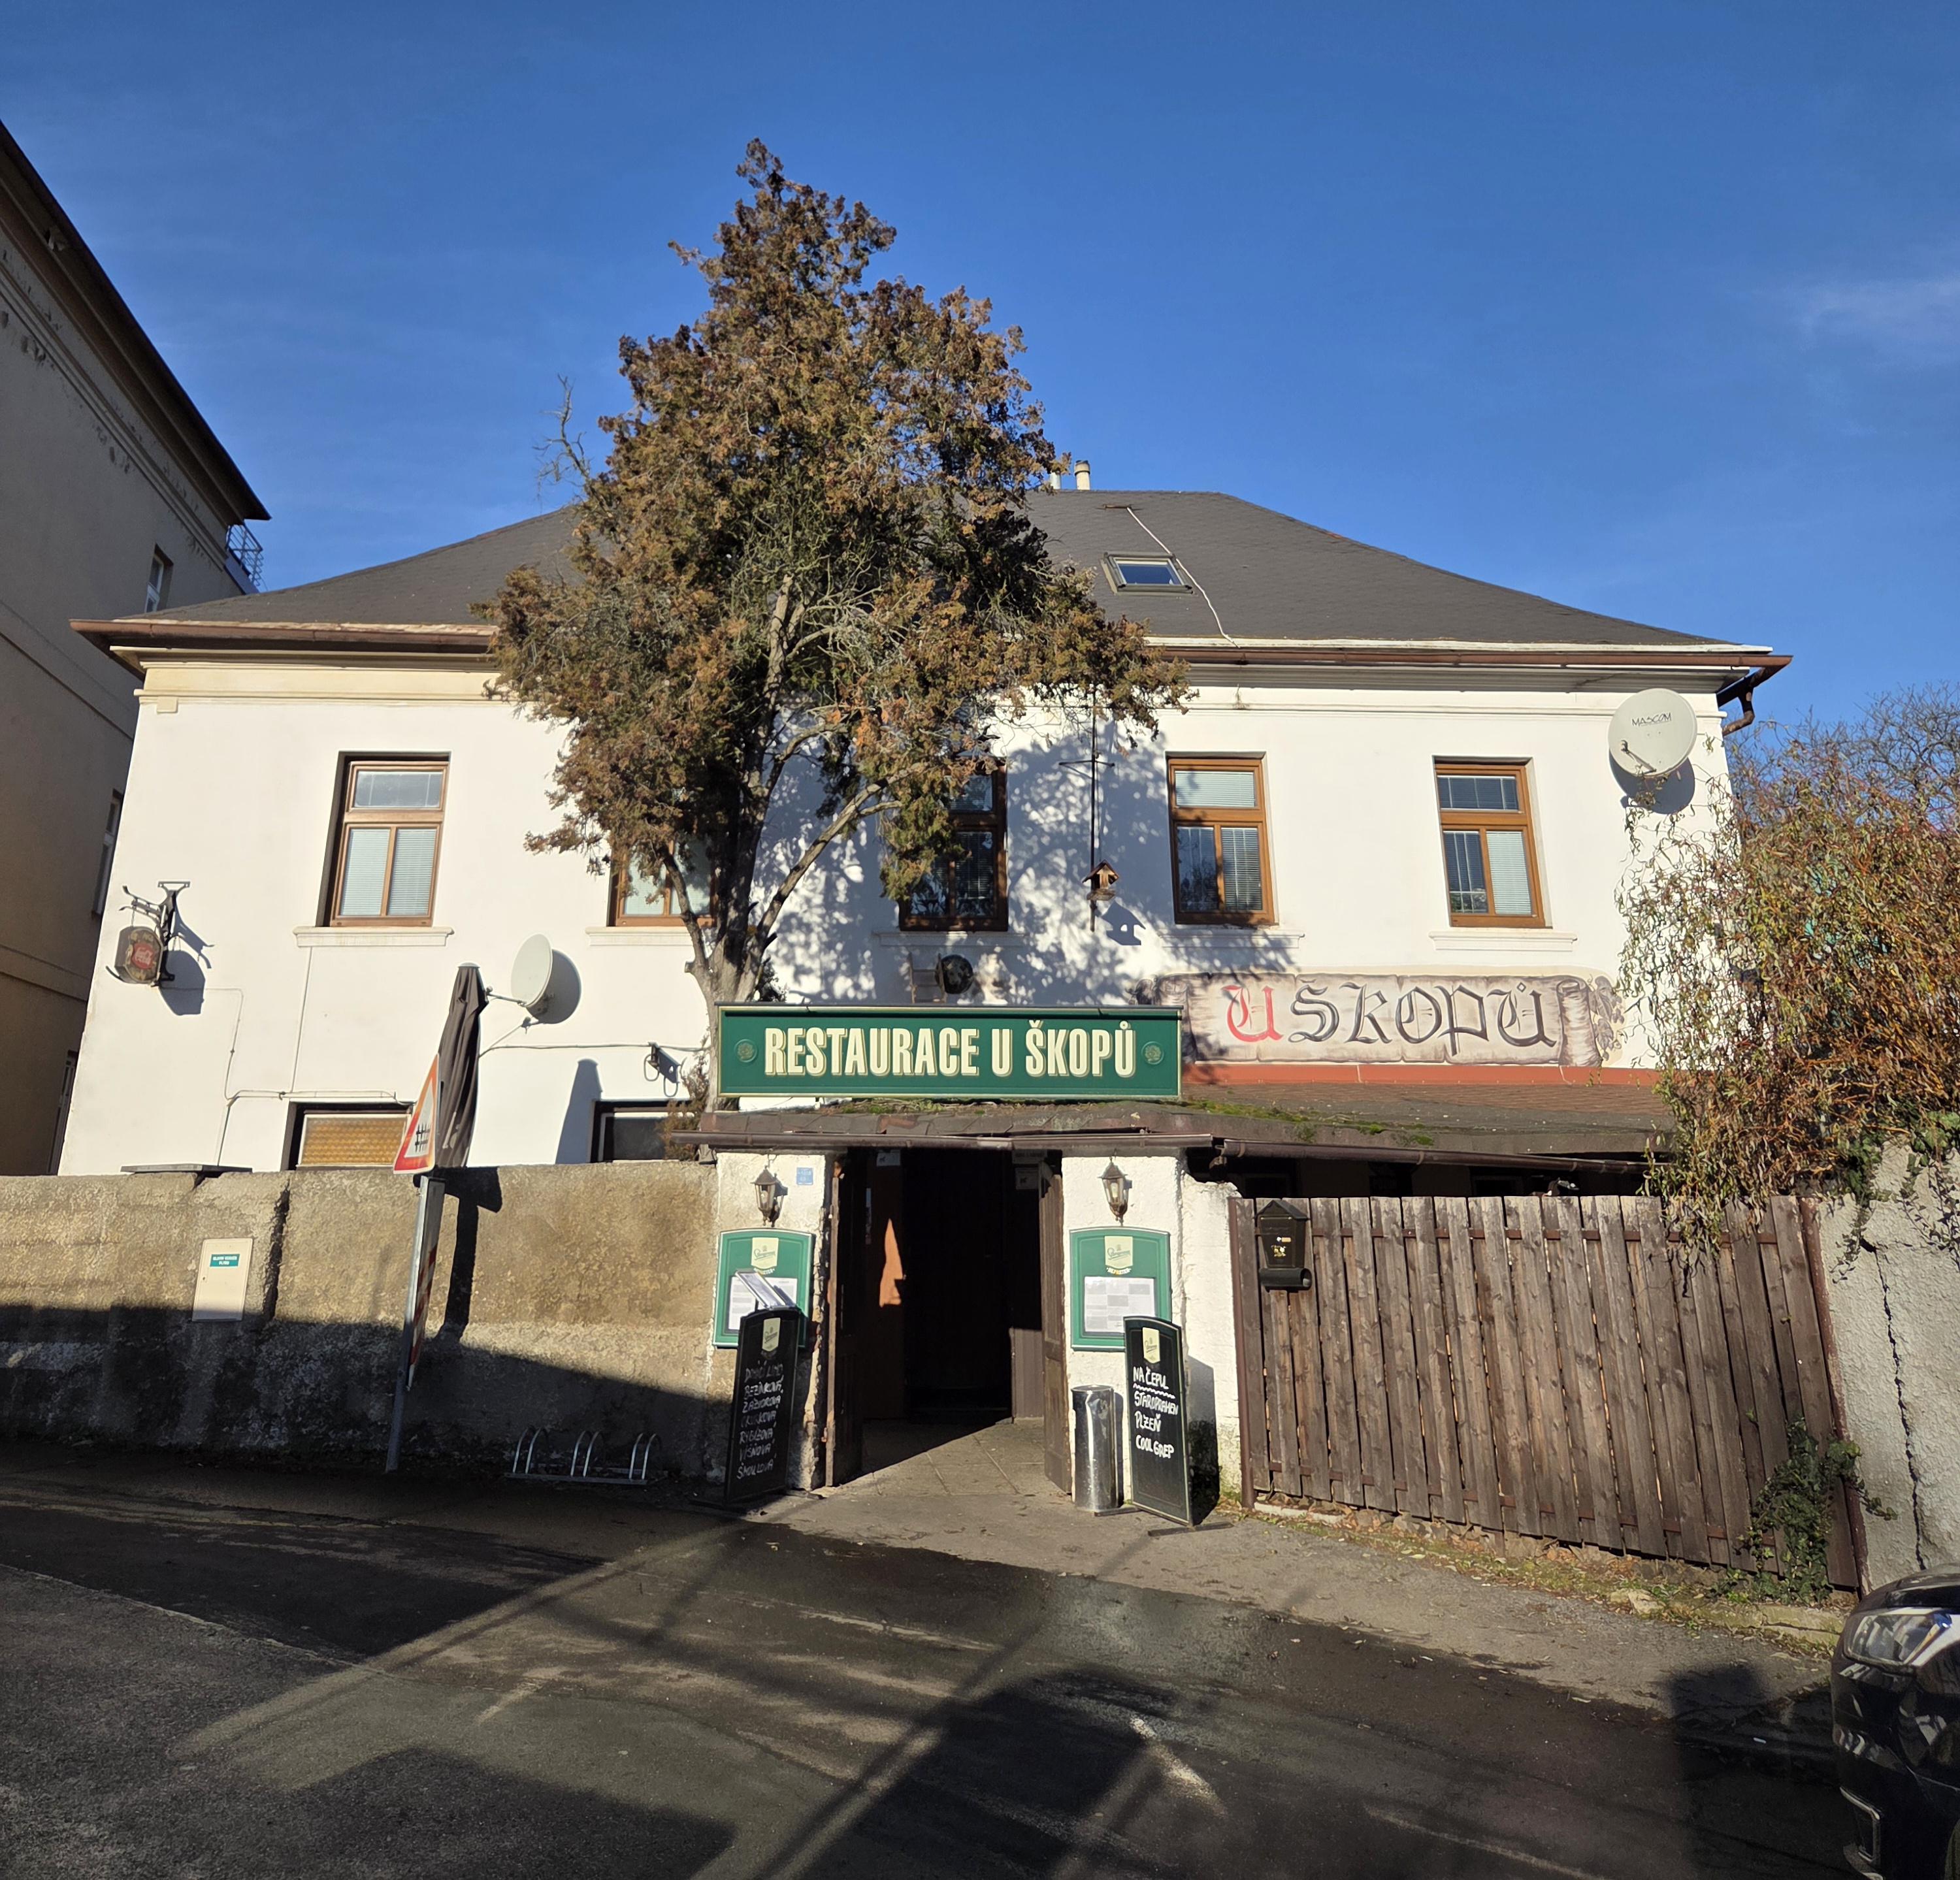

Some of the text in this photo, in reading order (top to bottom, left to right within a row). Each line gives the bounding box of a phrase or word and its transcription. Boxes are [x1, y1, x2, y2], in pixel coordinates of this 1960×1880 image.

[1632, 712, 1673, 727] MASCOM
[1222, 984, 1284, 1043] U
[764, 1019, 1136, 1077] RESTAURACE U ŠKOPŮ
[1133, 1366, 1145, 1383] NA
[1135, 1434, 1175, 1459] COOL GREP
